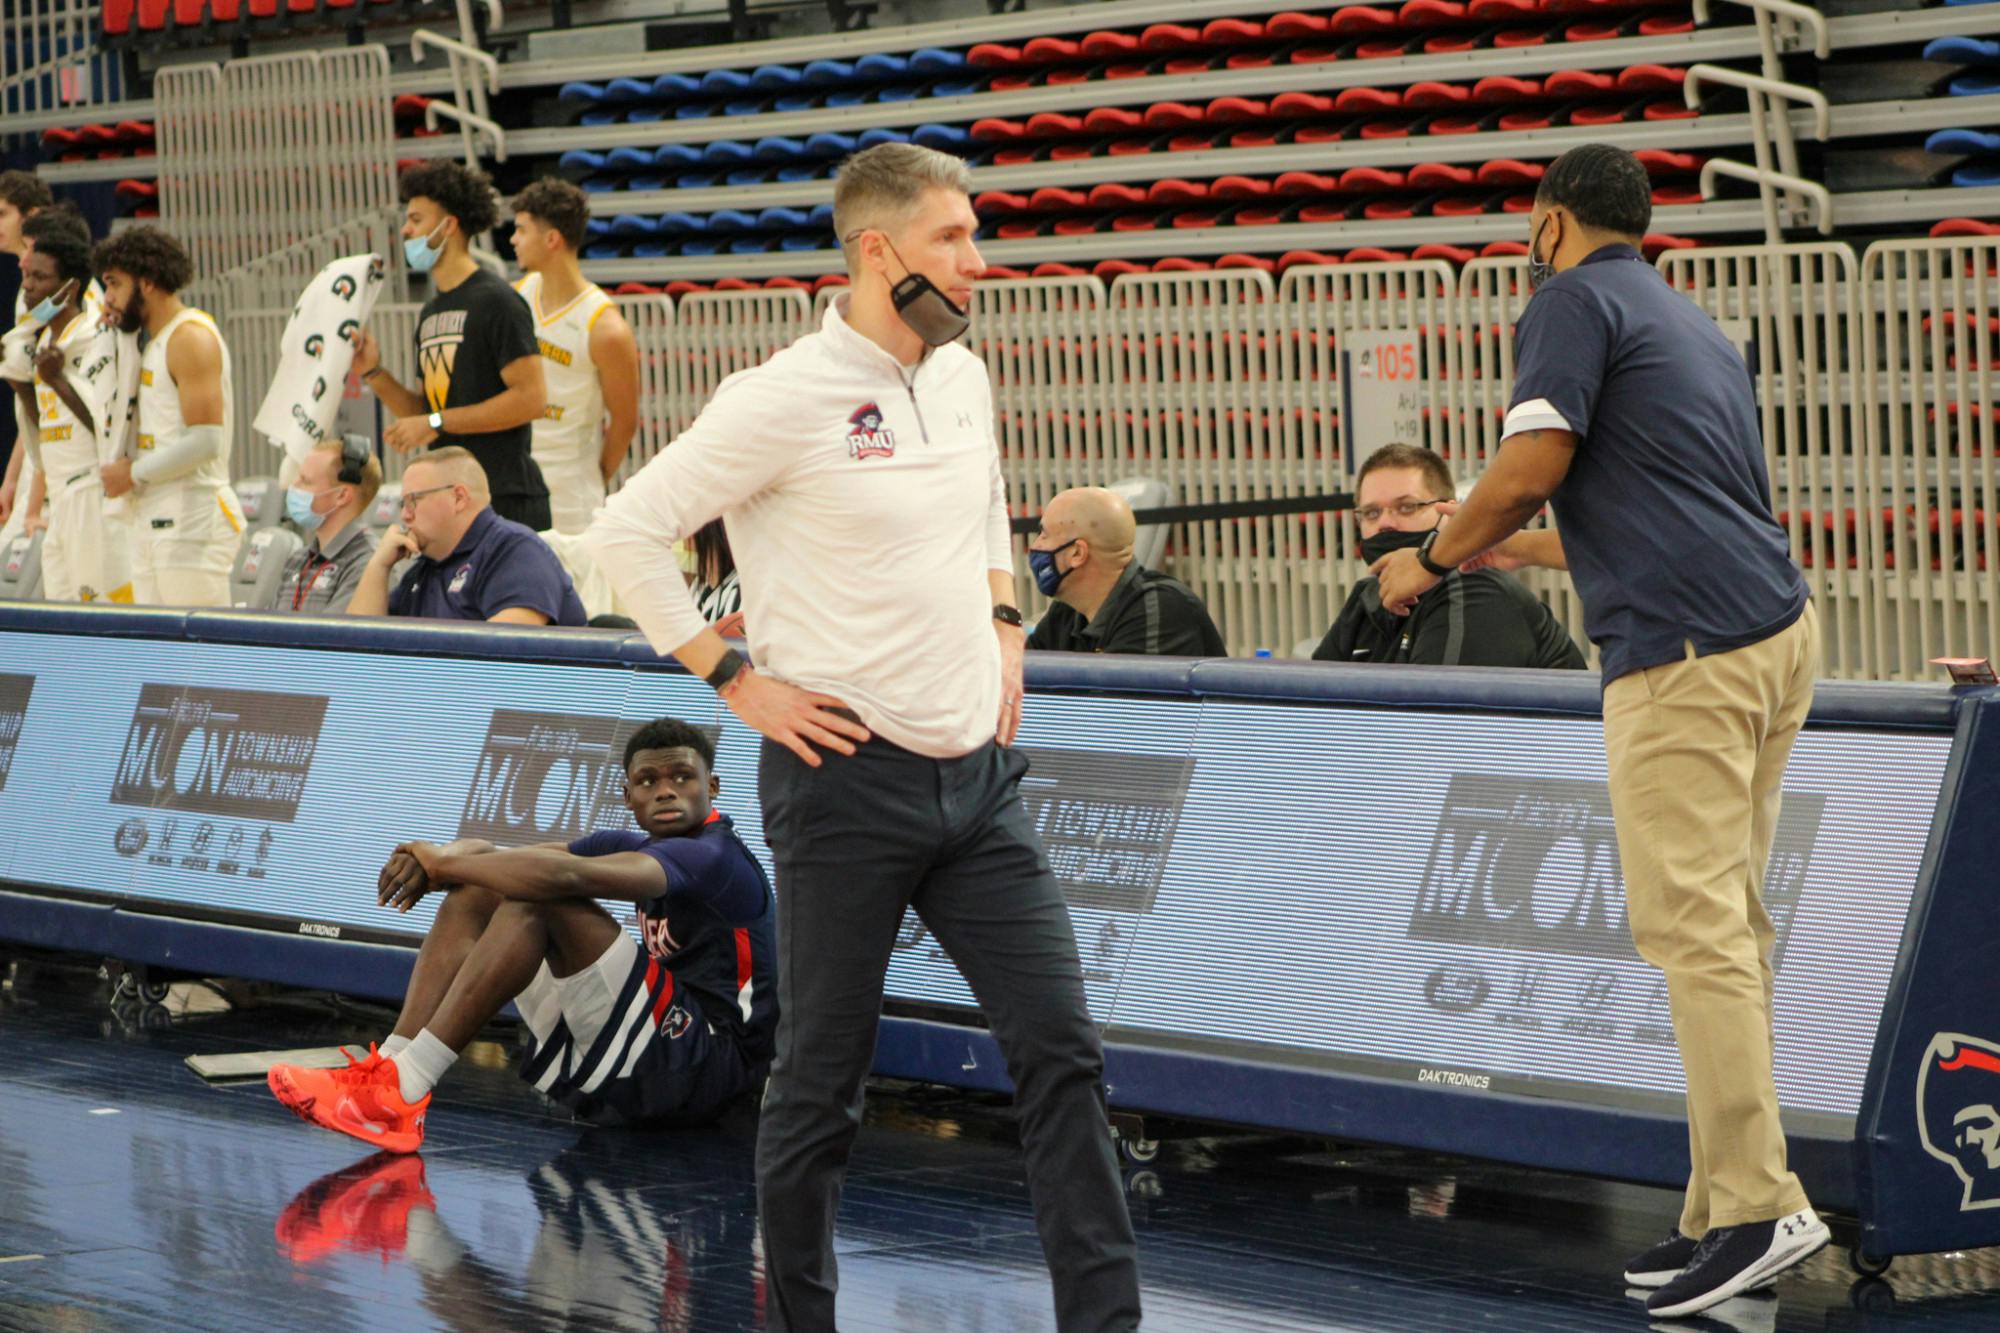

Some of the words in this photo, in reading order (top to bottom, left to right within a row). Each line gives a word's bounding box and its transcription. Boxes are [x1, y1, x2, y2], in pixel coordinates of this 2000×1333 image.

[1375, 343, 1417, 382] 105
[848, 431, 895, 457] RMU
[298, 922, 341, 938] DAKTRONICS
[1417, 1067, 1491, 1089] DAKTRONICS
